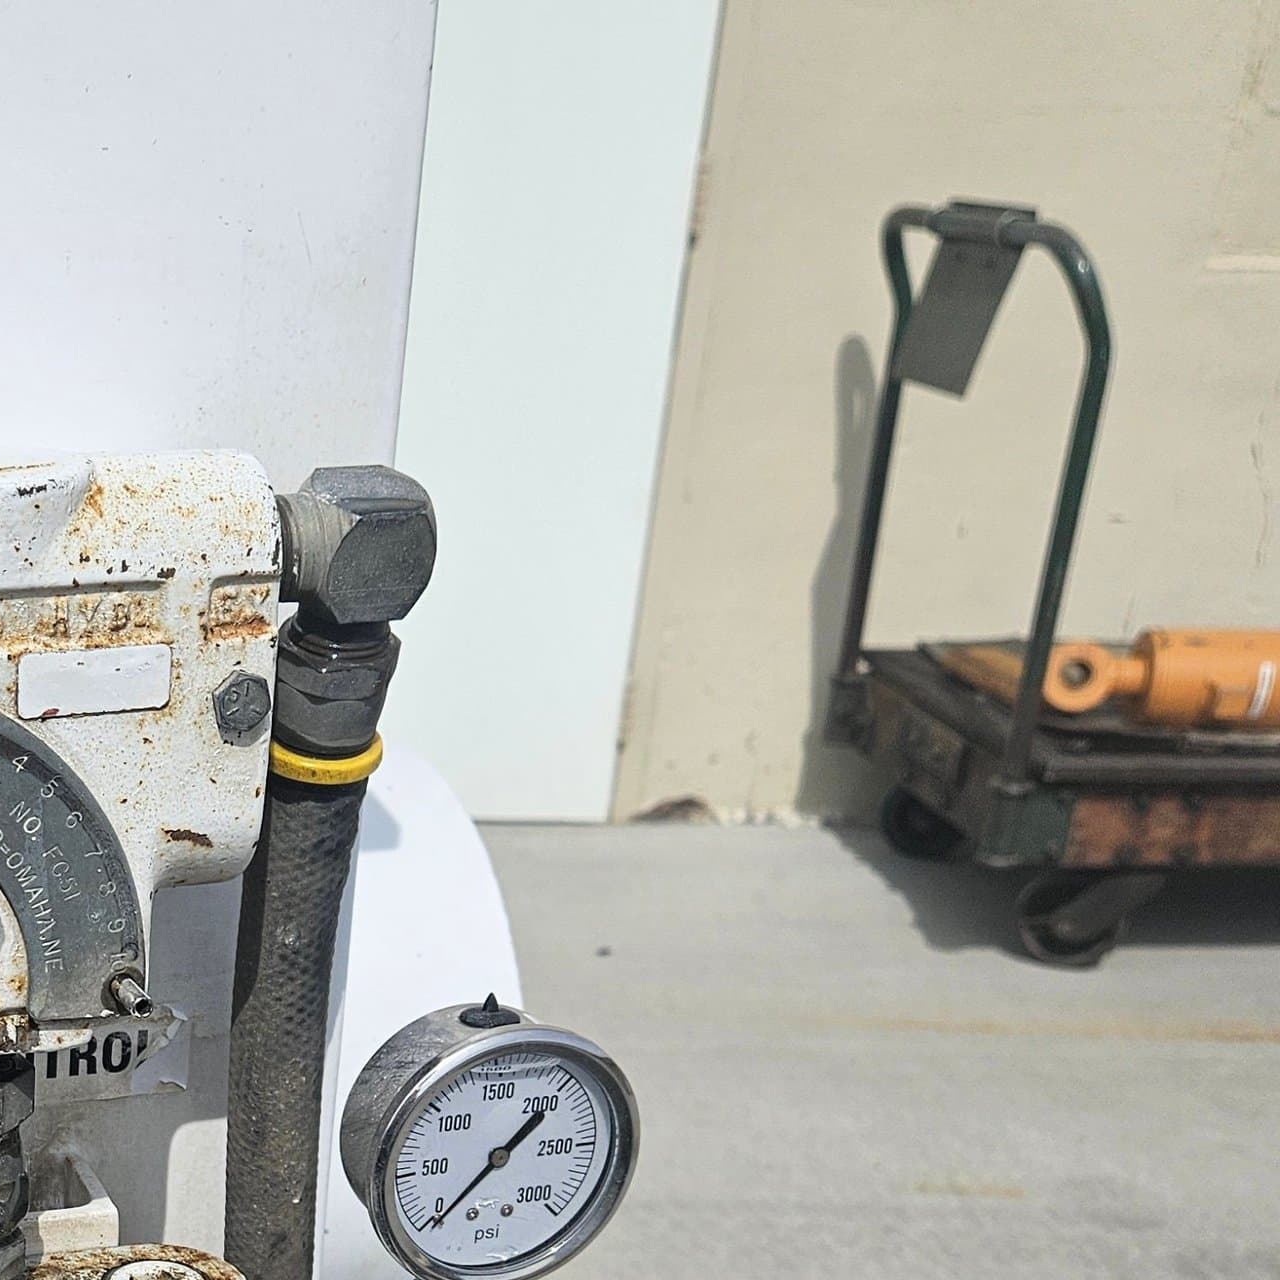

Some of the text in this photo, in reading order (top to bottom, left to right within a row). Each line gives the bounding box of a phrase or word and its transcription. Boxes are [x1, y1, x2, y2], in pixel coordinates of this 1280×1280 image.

[9, 801, 41, 841] NO.
[12, 755, 28, 773] 4
[41, 779, 59, 798] 5
[66, 811, 83, 829] 6
[84, 843, 103, 858] 7
[100, 881, 116, 897] 8
[108, 918, 127, 933] 9
[482, 1082, 515, 1101] 1500
[522, 1095, 558, 1114] 2000
[437, 1113, 471, 1132] 1000
[537, 1138, 572, 1157] 2500
[422, 1158, 448, 1175] 500
[516, 1184, 551, 1203] 3000
[434, 1197, 444, 1213] 0
[474, 1224, 500, 1243] psi
